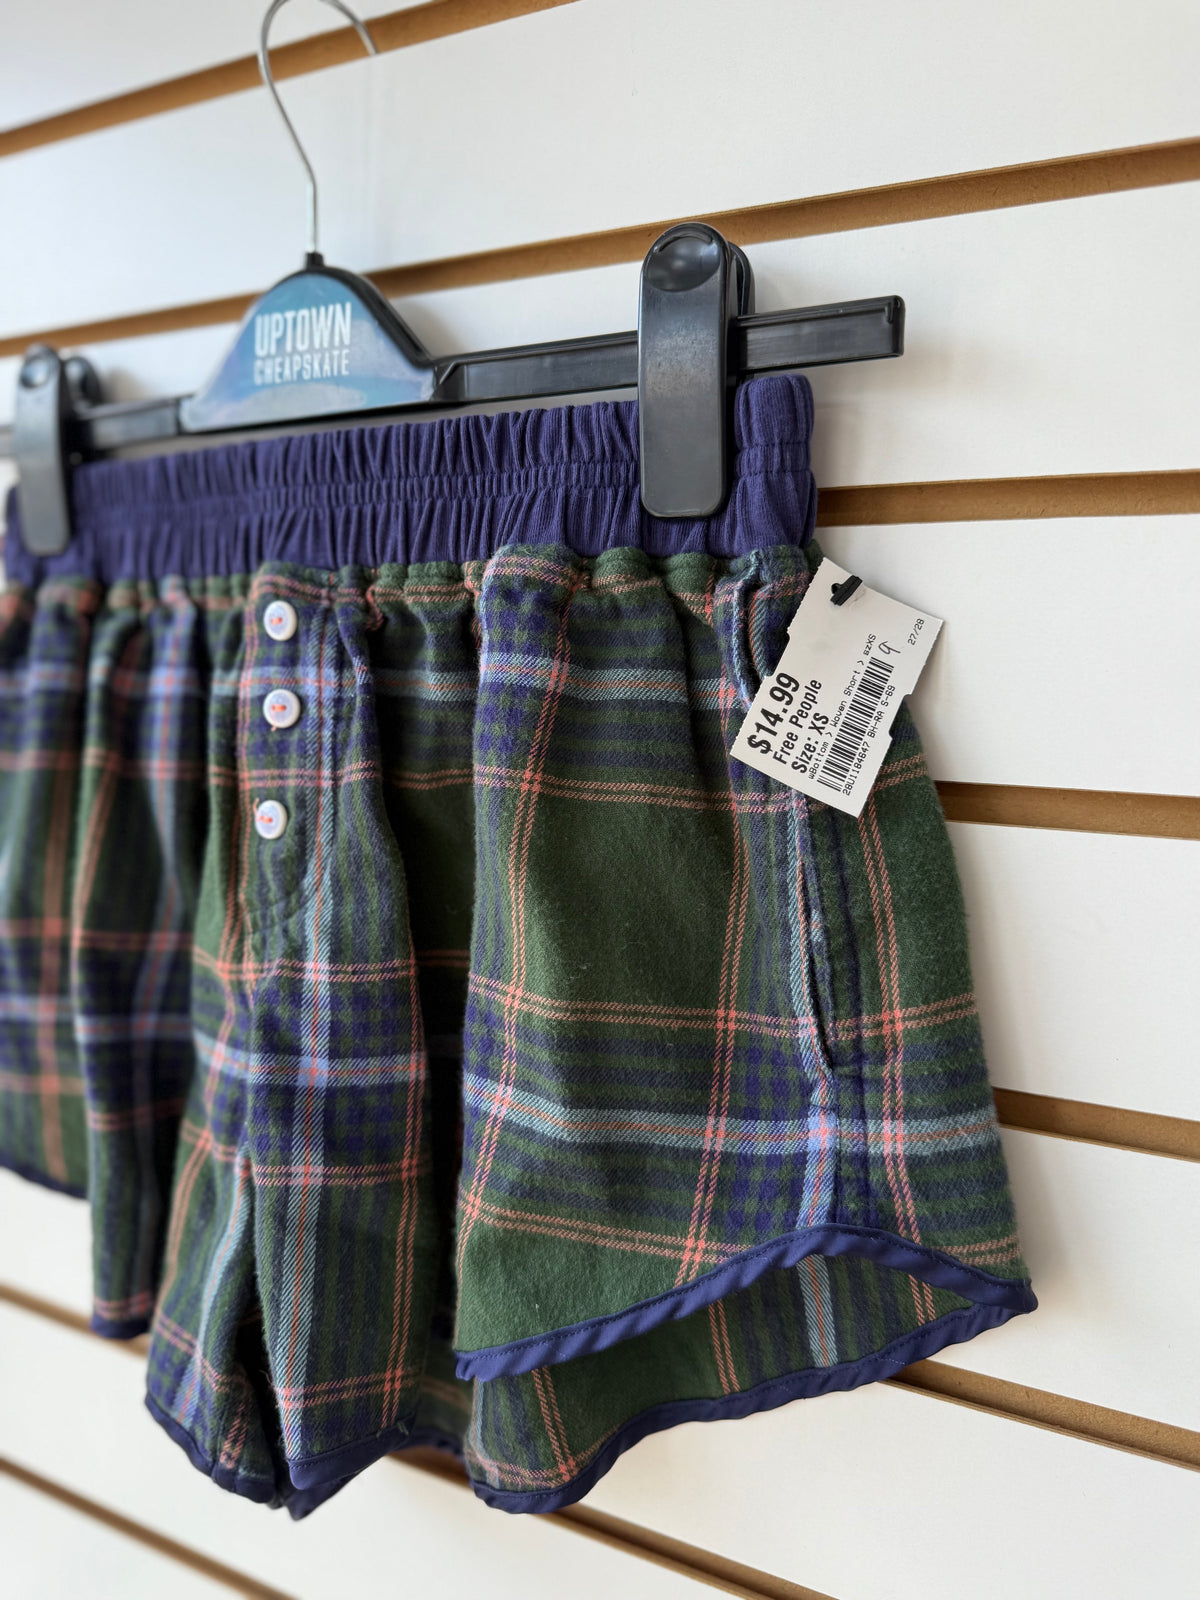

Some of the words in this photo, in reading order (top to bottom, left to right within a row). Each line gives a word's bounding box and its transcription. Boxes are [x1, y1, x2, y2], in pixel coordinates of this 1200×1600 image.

[255, 302, 352, 357] UPTOWN
[254, 349, 350, 385] CHEAPSKATE
[907, 618, 925, 646] 27/28
[747, 672, 800, 755] $14.99
[772, 731, 799, 765] Free
[788, 679, 822, 729] People
[808, 741, 829, 780] wBottom
[829, 700, 847, 728] Woven
[843, 670, 860, 697] Short
[863, 633, 876, 656] szXS
[866, 710, 885, 738] BH-RA
[880, 684, 895, 707] S-69
[791, 736, 819, 774] Size:
[808, 712, 829, 736] XS
